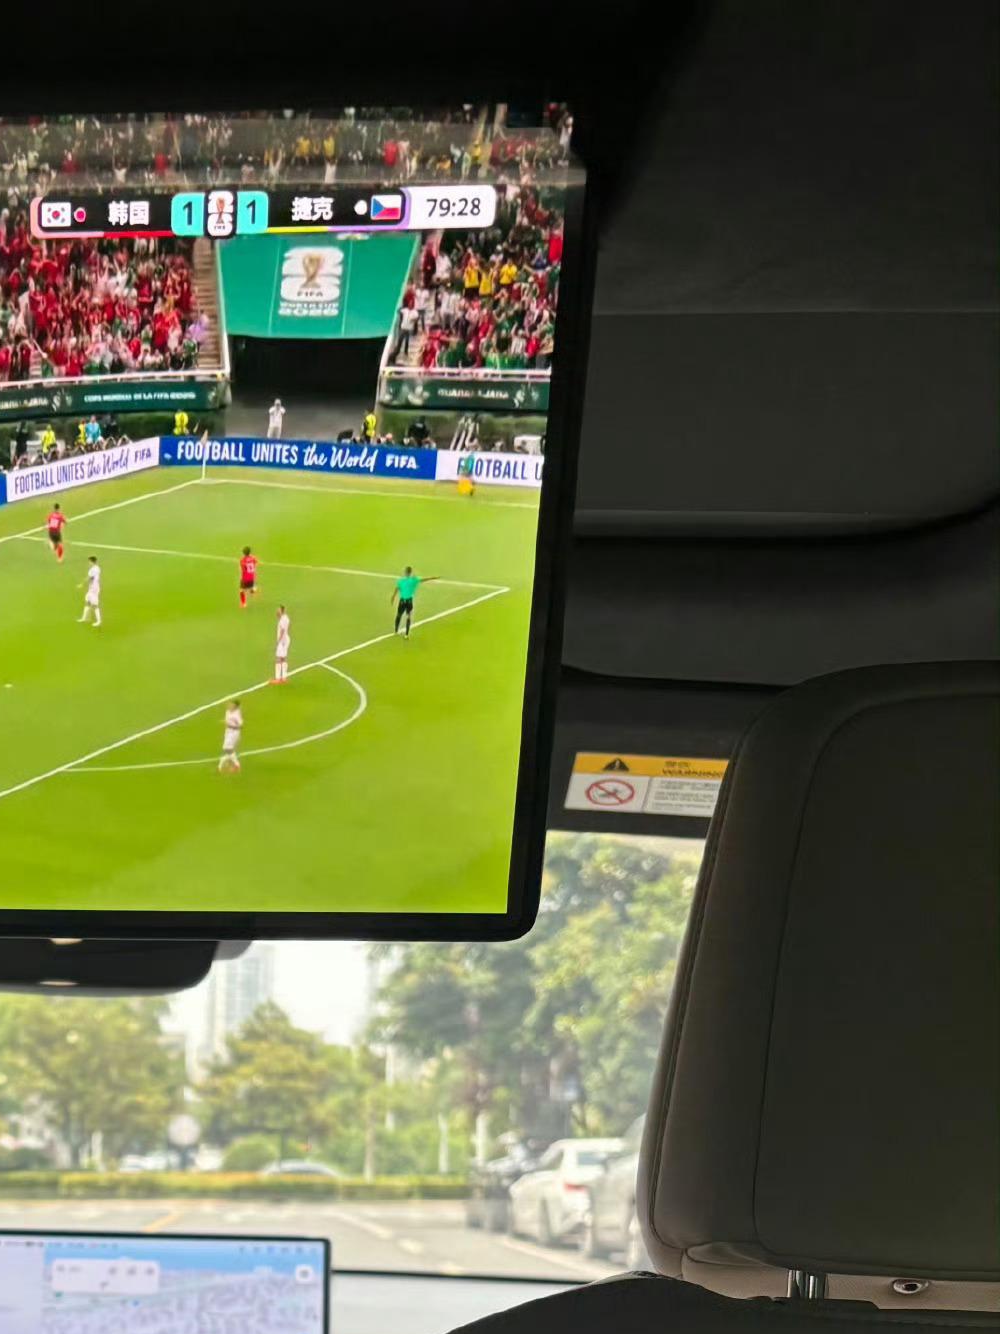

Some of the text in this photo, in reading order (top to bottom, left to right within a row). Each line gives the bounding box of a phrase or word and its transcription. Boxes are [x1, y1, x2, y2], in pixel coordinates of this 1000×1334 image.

[107, 200, 149, 226] 韩国
[181, 200, 193, 226] 1
[245, 199, 257, 225] 1
[291, 196, 334, 222] 捷克
[426, 197, 481, 218] 79:28
[177, 440, 418, 473] FOOTBALL UNITES the World FIFA
[14, 447, 152, 495] FOOTBALL UNITES the World FIFA
